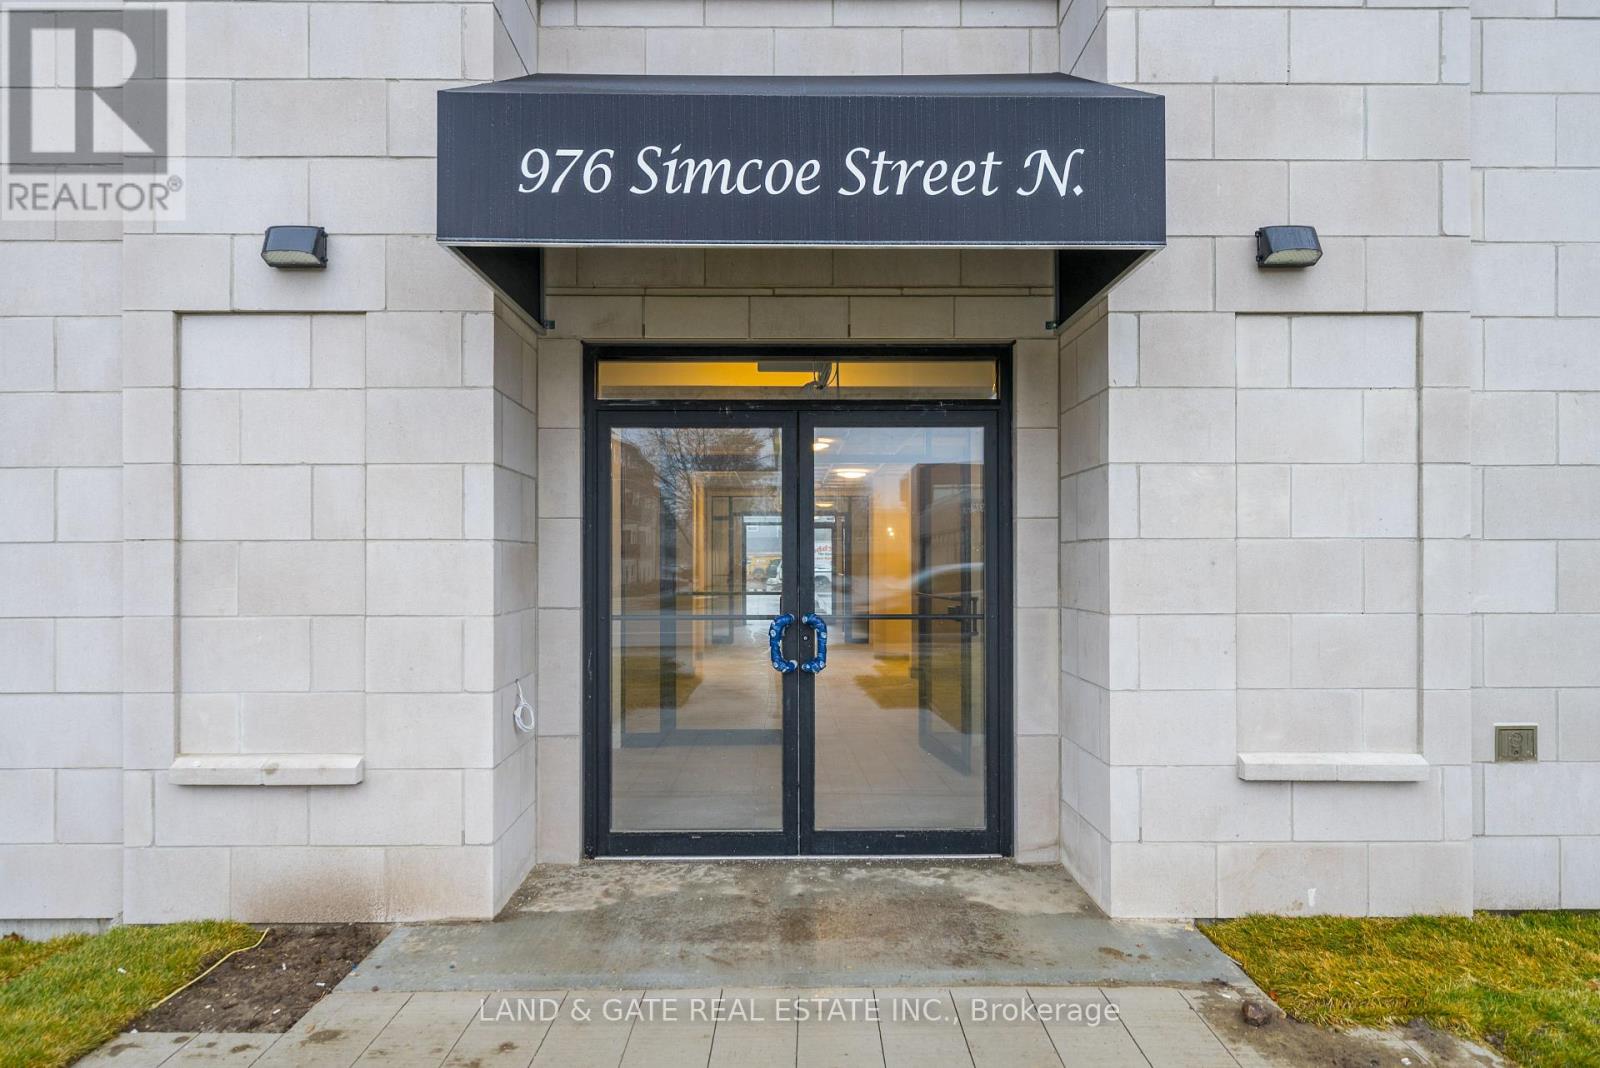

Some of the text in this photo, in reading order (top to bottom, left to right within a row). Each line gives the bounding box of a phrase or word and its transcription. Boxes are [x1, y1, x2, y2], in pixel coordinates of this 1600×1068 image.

[518, 143, 1085, 198] 976 Simcoe Street N.
